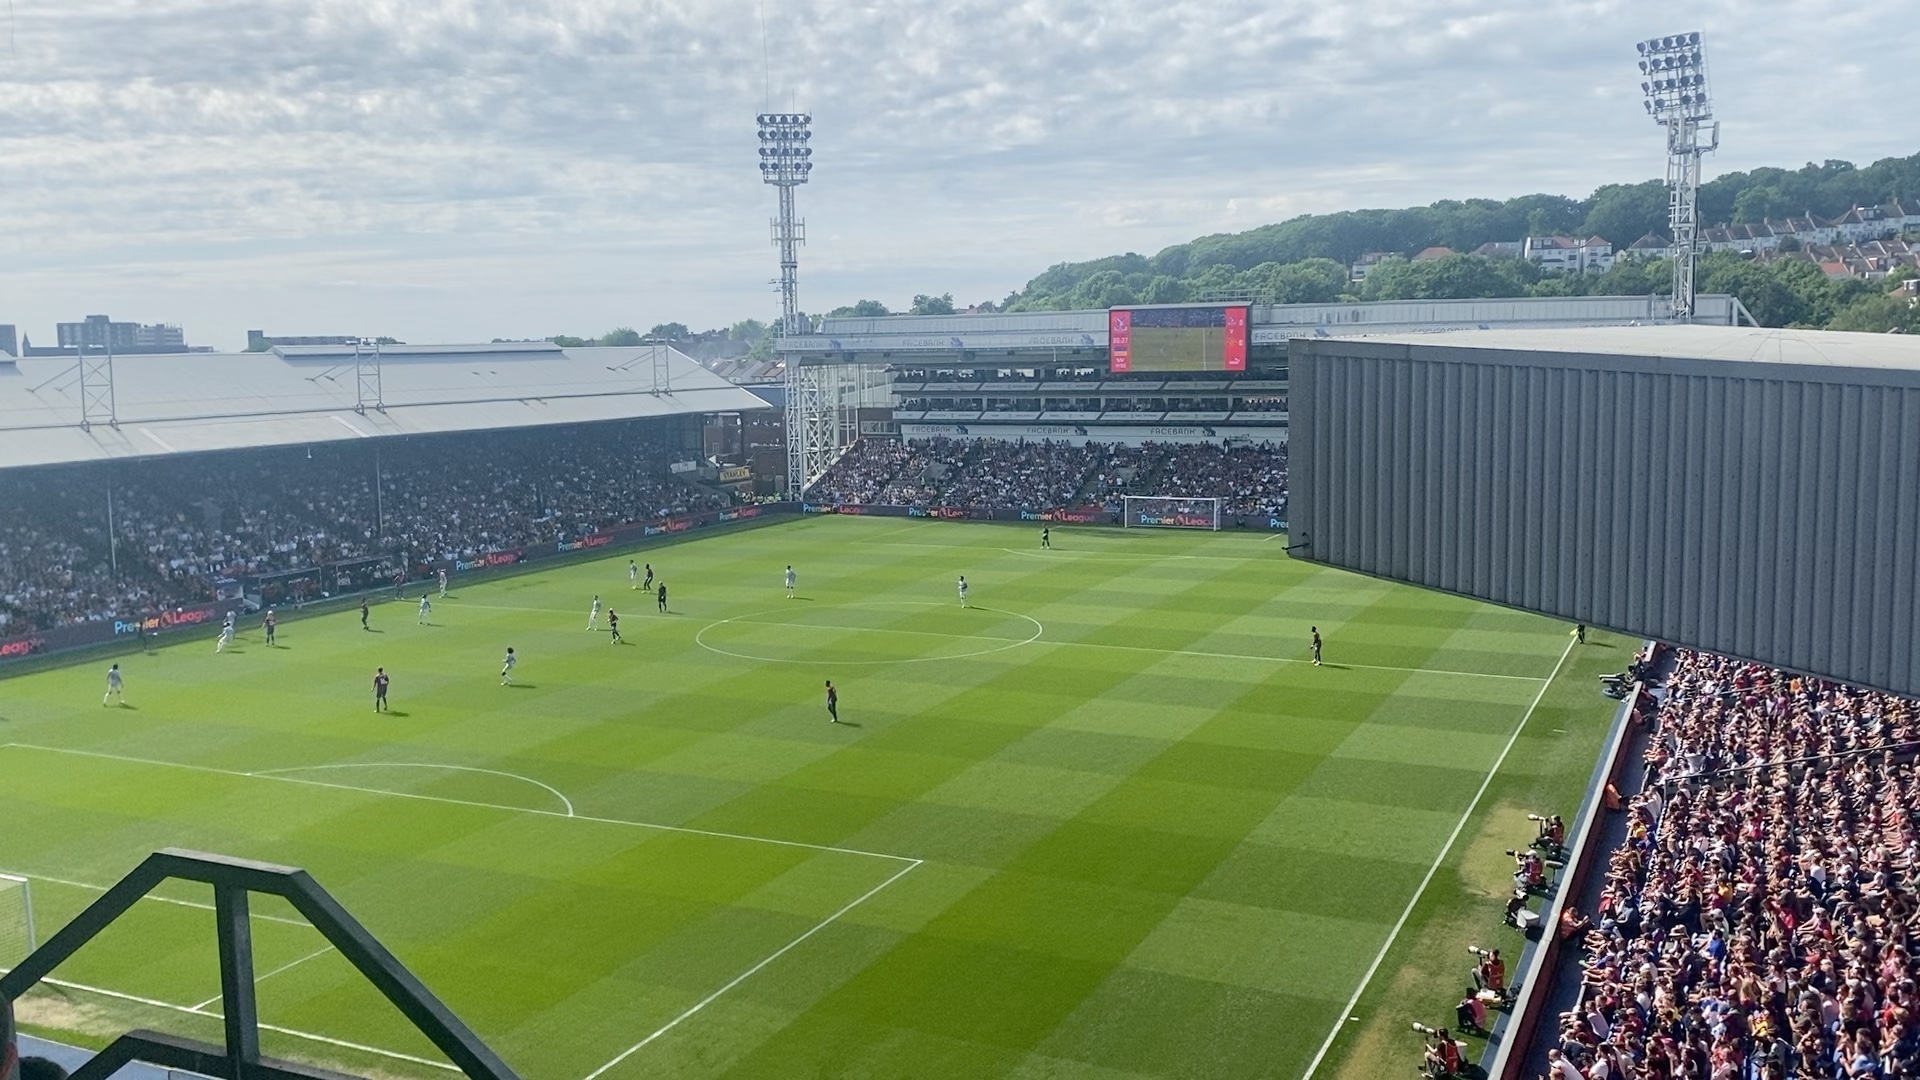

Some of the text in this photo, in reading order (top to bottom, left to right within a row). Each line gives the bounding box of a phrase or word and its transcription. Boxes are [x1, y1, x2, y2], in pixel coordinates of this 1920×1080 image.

[902, 339, 944, 347] FACEBANK
[1029, 336, 1073, 345] FACEBANK
[1021, 511, 1052, 521] Premier
[1141, 514, 1174, 525] Premier
